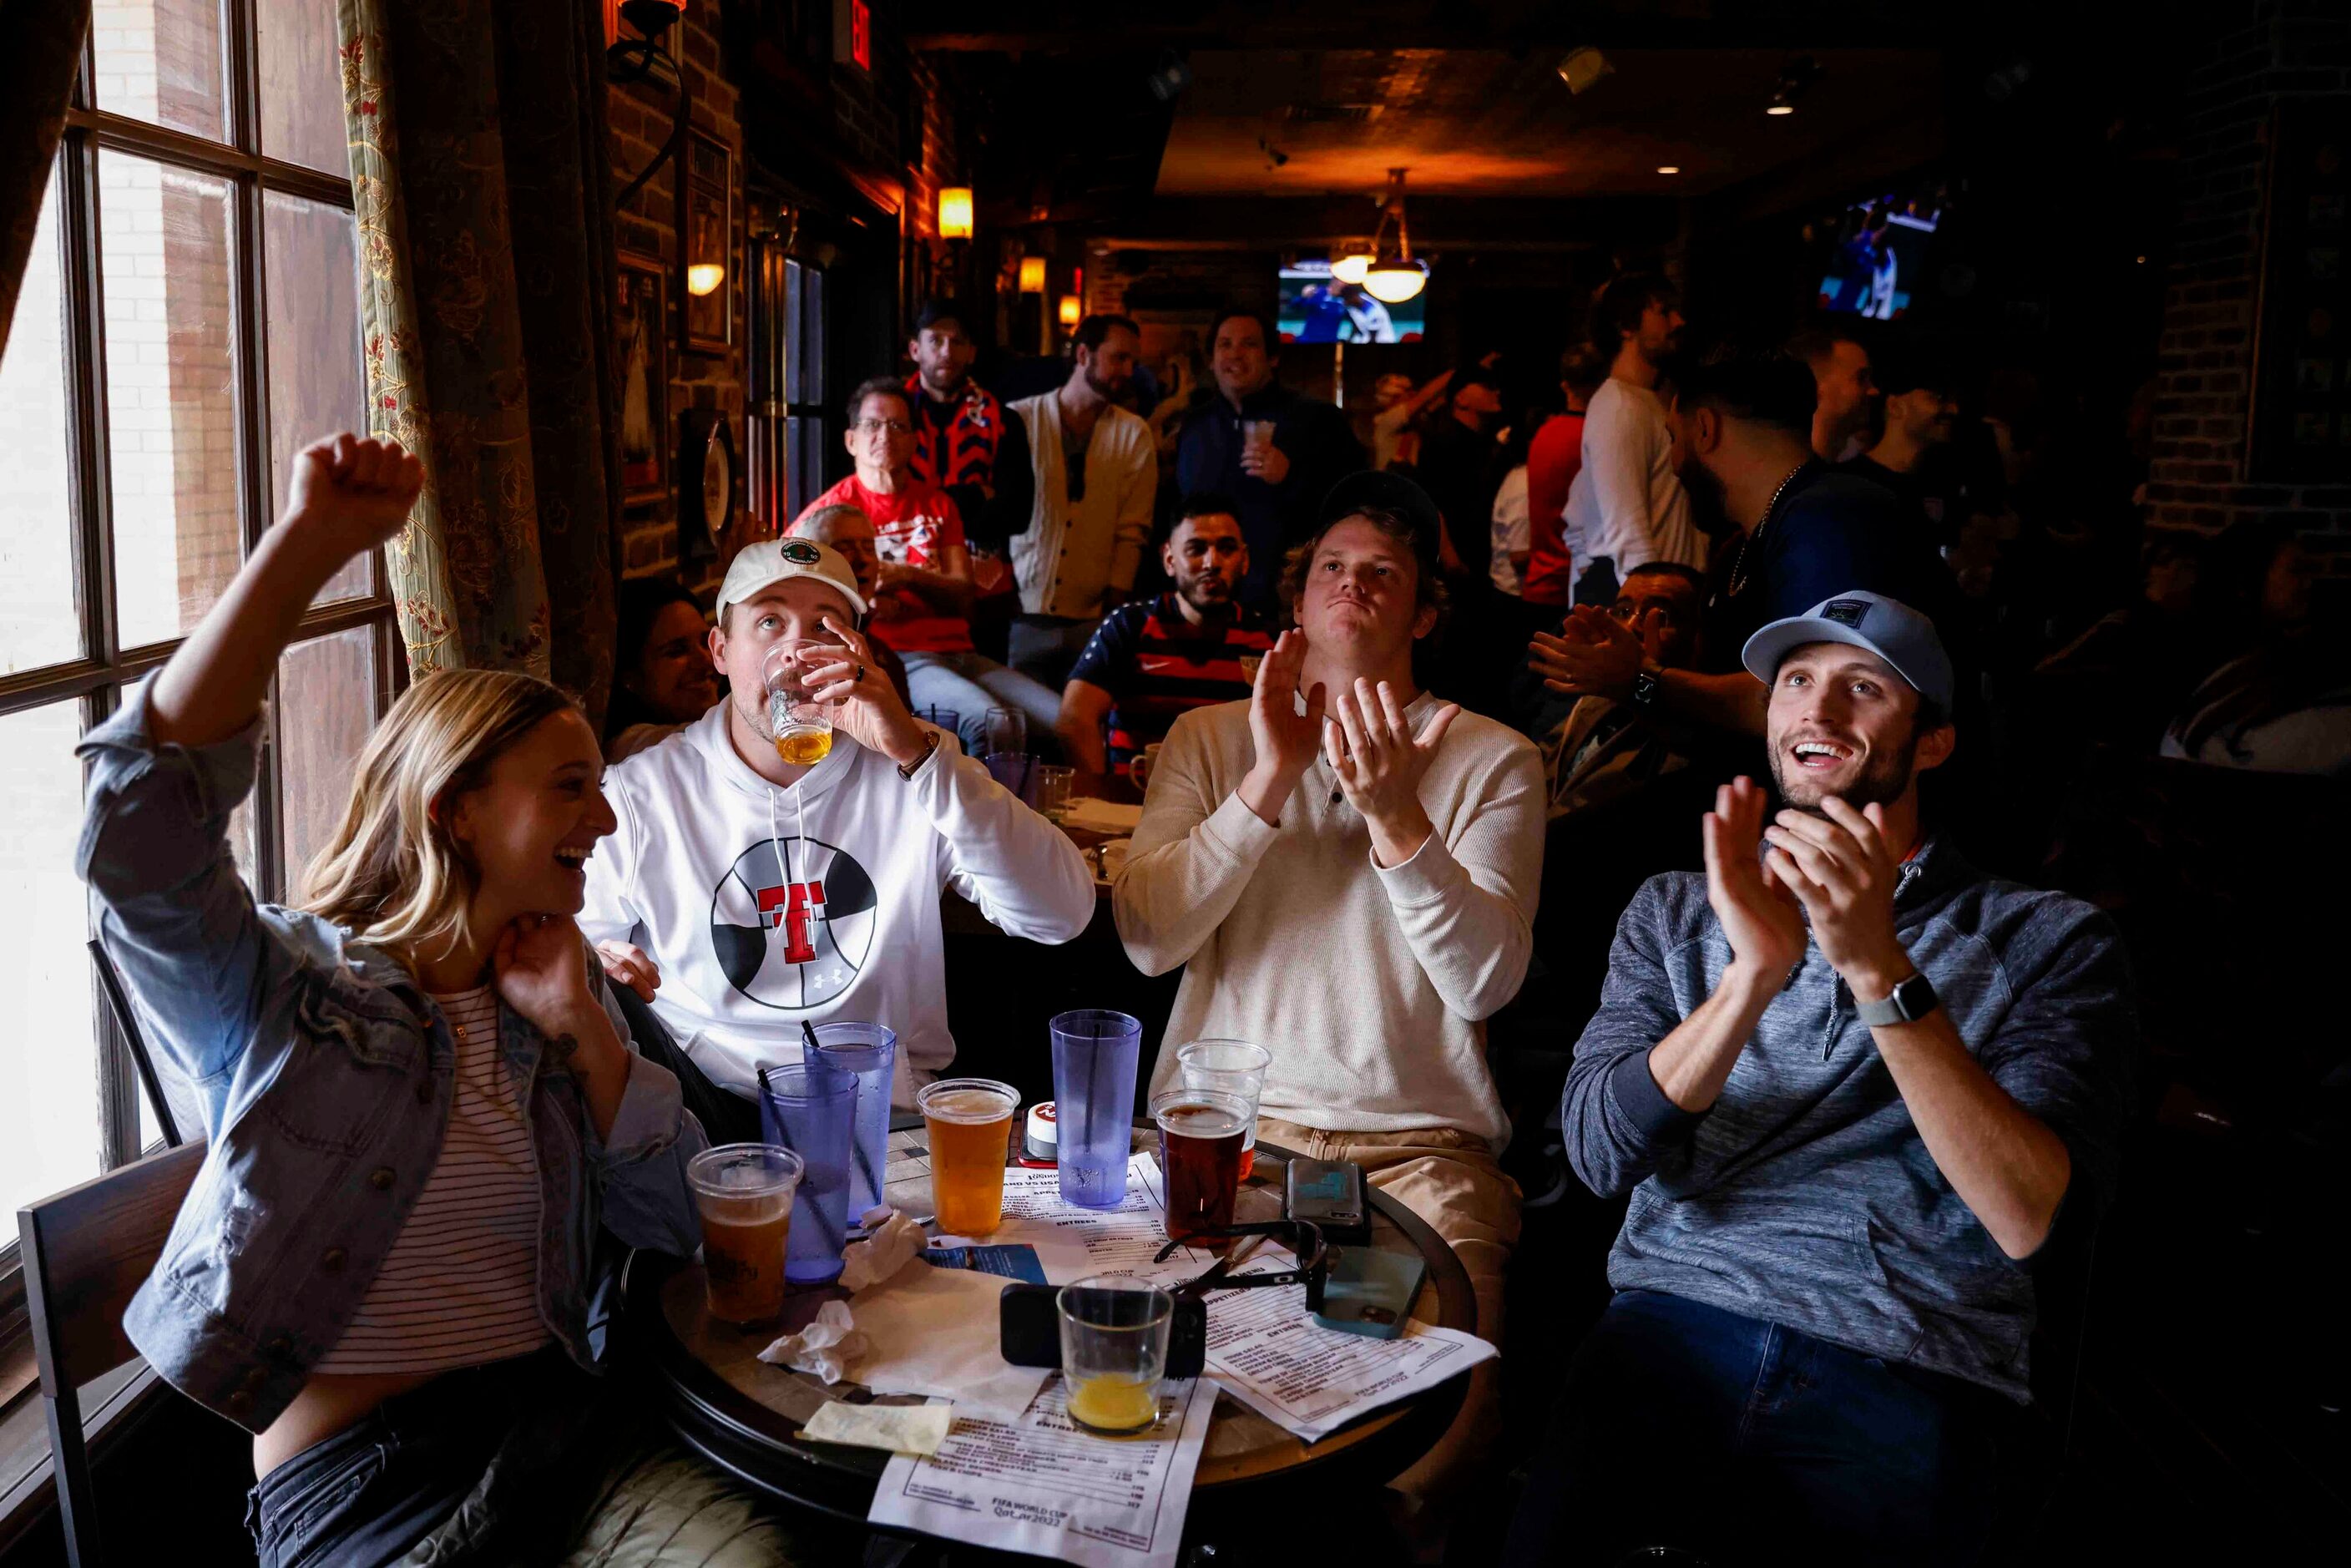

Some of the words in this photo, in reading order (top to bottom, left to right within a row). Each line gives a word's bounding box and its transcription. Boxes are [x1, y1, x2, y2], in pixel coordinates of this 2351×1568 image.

[992, 1497, 1013, 1508] FIFA
[1014, 1502, 1048, 1515] WORLD
[1049, 1510, 1068, 1519] CUP
